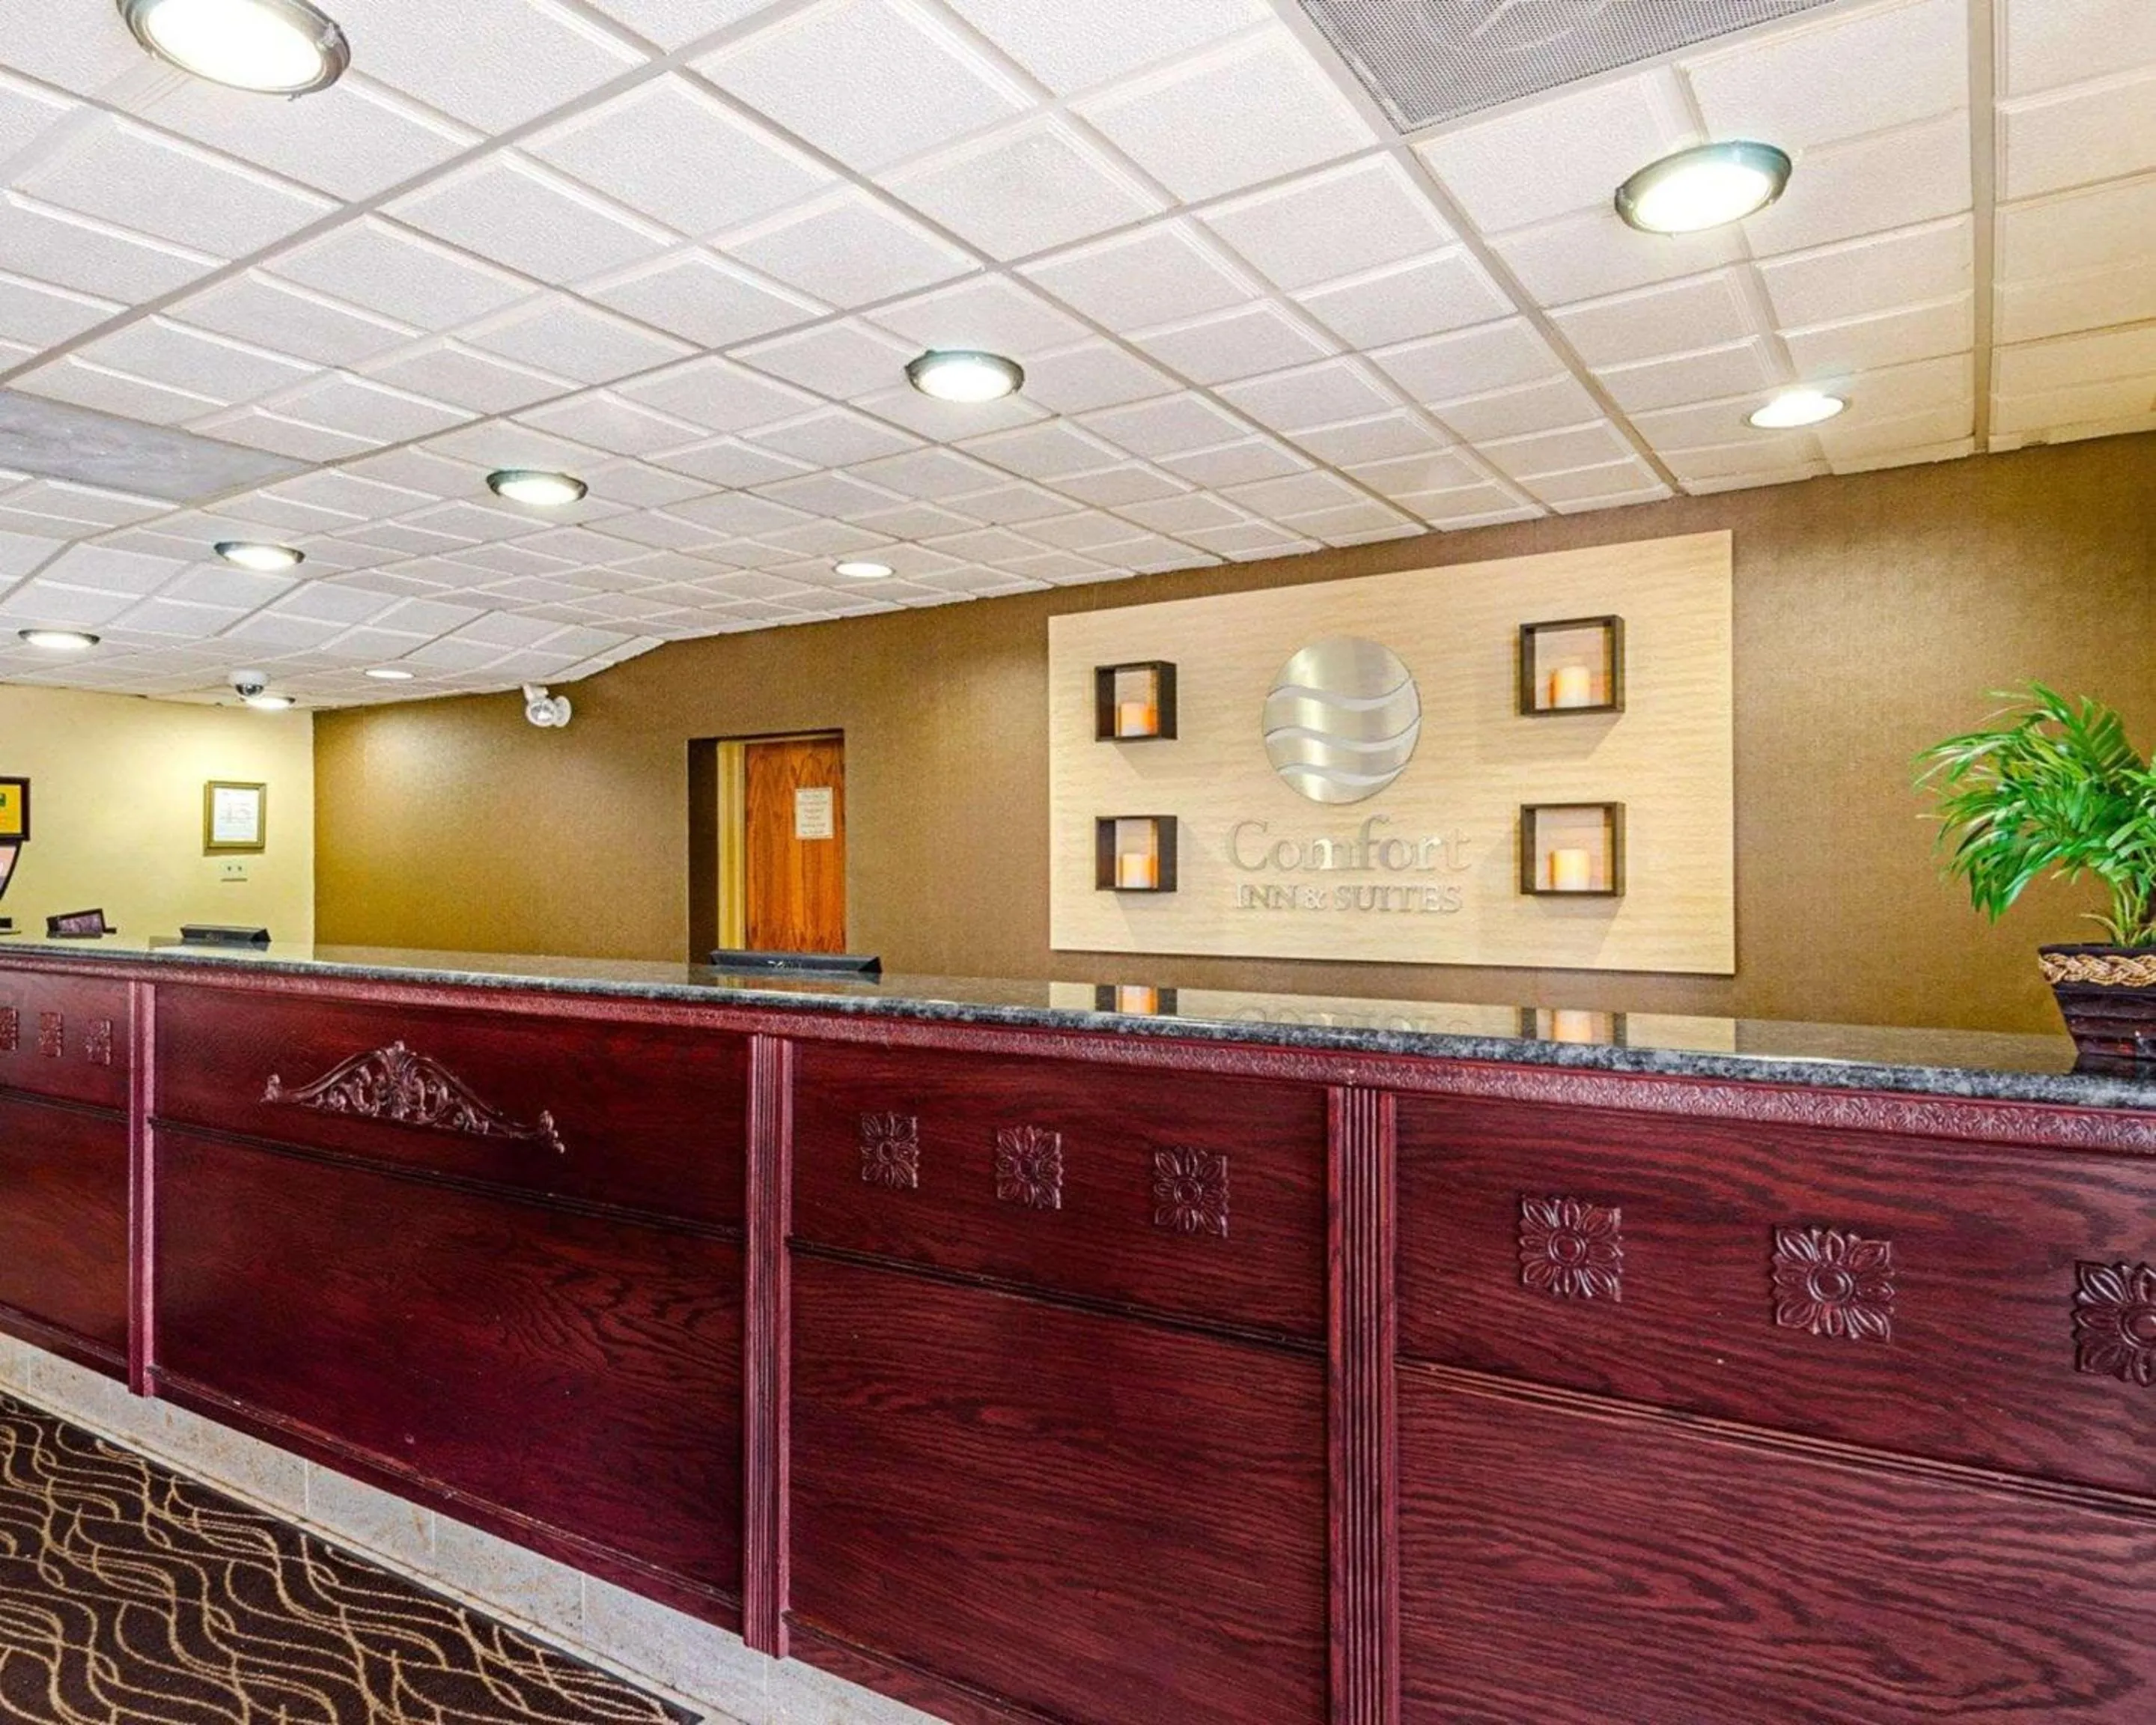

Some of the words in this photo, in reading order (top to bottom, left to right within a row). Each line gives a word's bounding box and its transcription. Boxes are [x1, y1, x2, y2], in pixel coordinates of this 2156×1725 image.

[1228, 814, 1473, 871] Comfort
[1235, 884, 1299, 910] INN
[1303, 884, 1328, 911] &
[1333, 883, 1464, 913] SUITES
